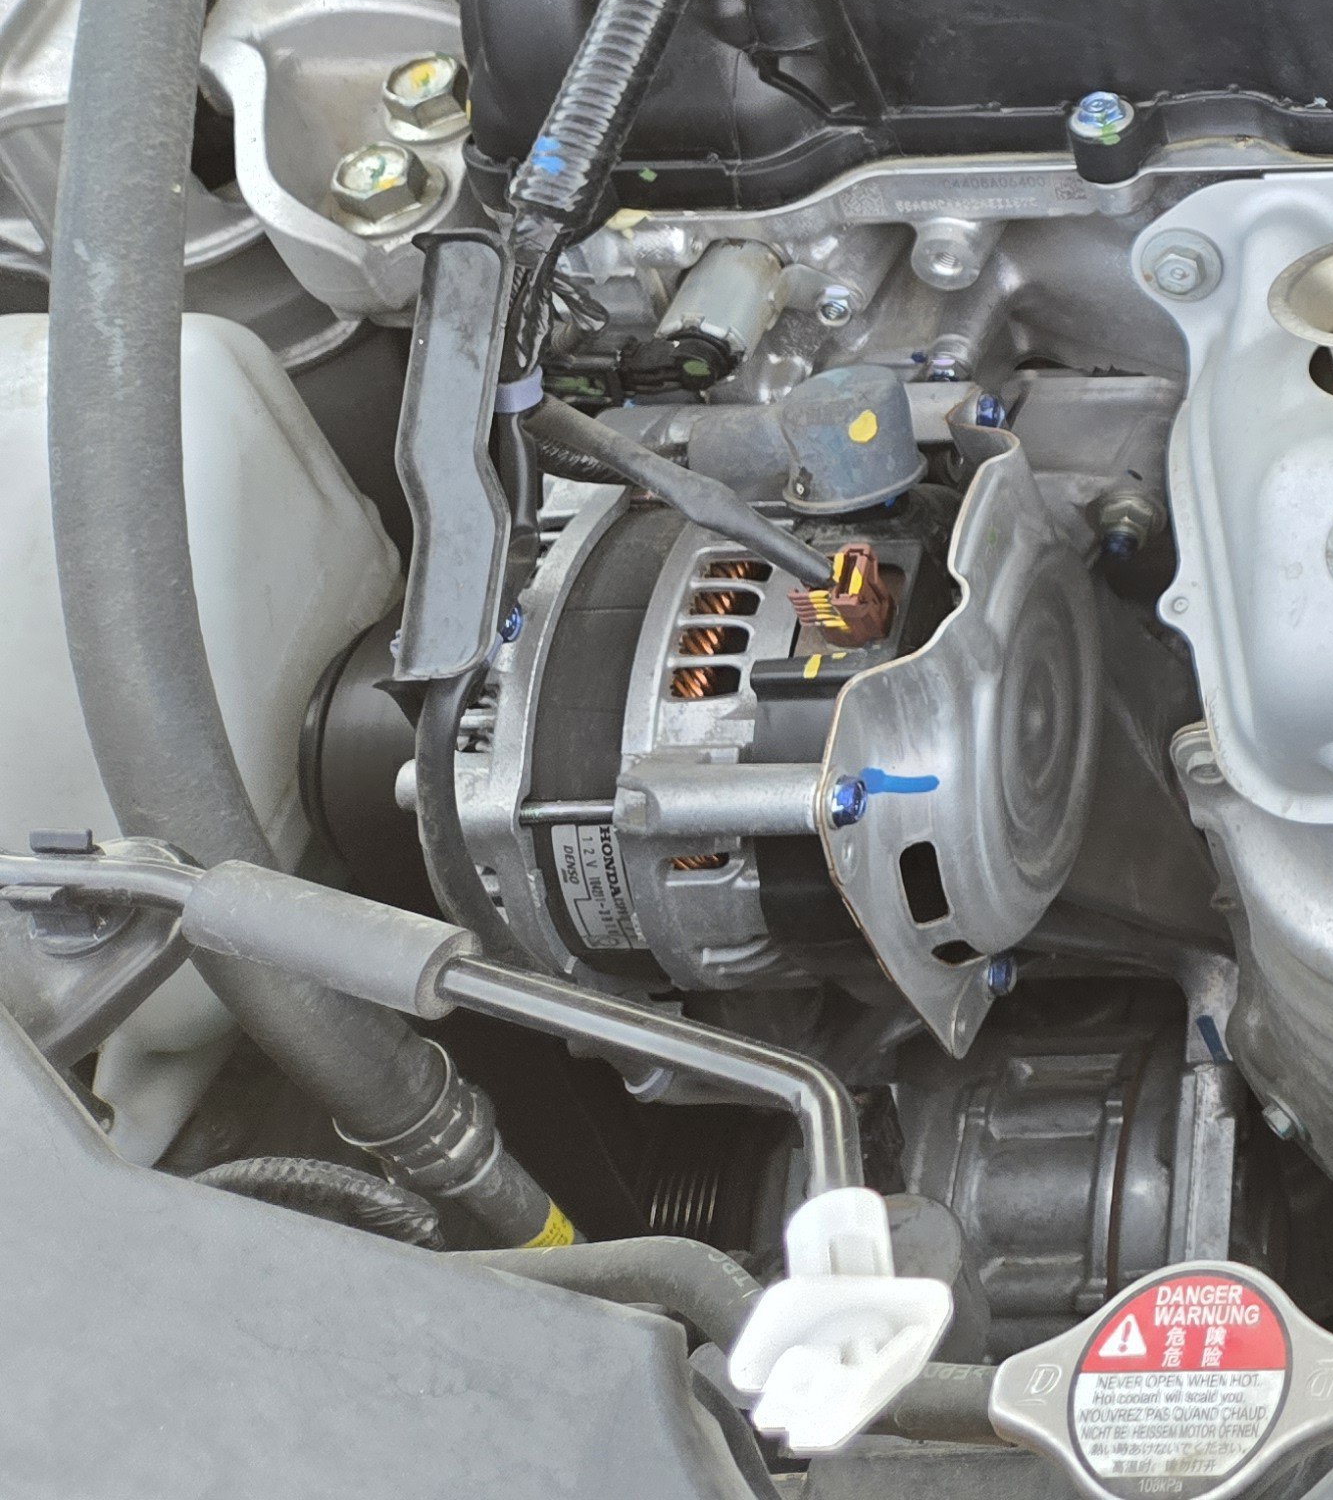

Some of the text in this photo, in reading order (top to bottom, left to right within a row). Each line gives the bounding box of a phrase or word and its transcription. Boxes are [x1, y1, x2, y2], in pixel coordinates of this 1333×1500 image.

[563, 845, 580, 885] DENSO
[599, 826, 622, 898] HONDA
[1156, 1285, 1243, 1305] DANGER
[1154, 1305, 1260, 1326] WARNUNG
[1096, 1375, 1143, 1389] NEVER
[1145, 1374, 1183, 1388] OPEN
[1186, 1373, 1227, 1387] WHEN
[1172, 1406, 1219, 1421] QUAND
[1180, 1424, 1216, 1438] MOTOR
